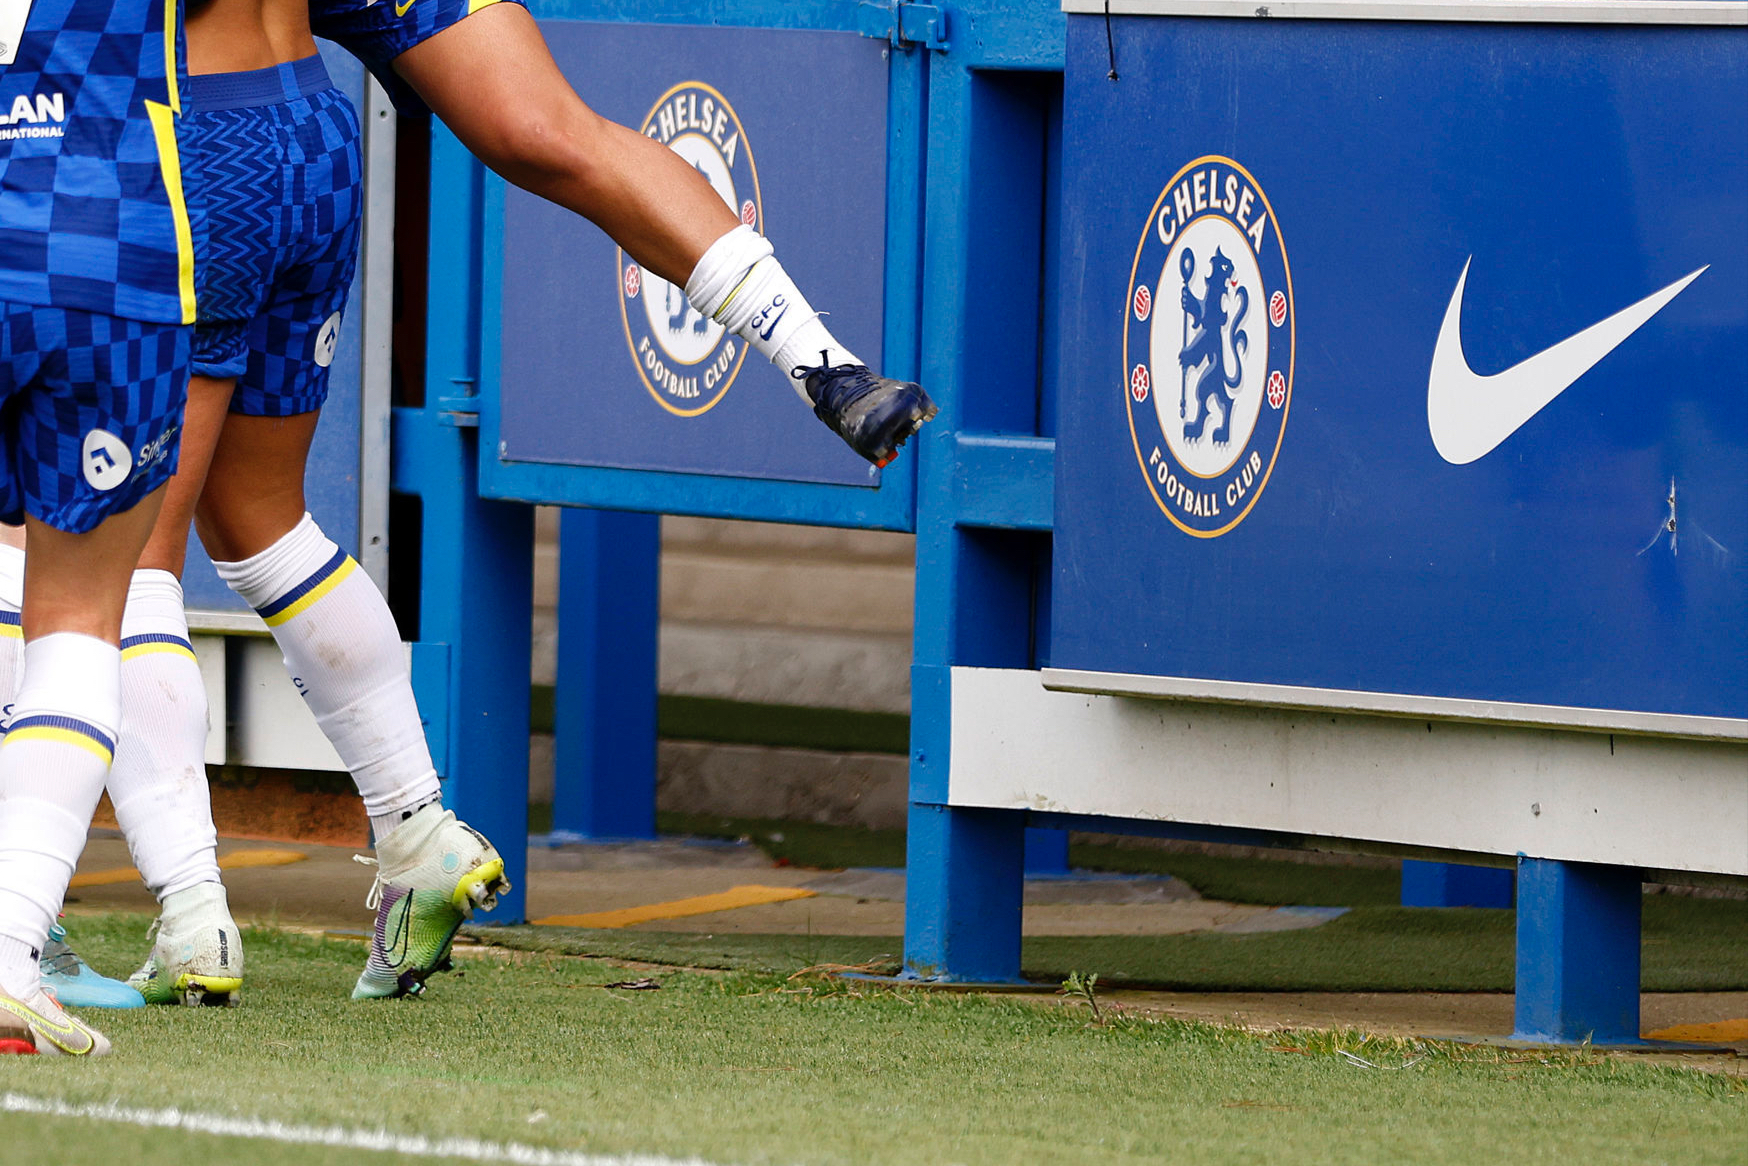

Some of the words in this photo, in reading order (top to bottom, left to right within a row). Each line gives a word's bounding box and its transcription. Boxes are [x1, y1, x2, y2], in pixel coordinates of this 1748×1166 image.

[1157, 170, 1267, 254] CHELSEA
[751, 294, 785, 329] CFC
[639, 335, 700, 398] FOOTBALL
[704, 340, 736, 389] CLUB
[1150, 446, 1220, 517] FOOTBALL
[1226, 451, 1262, 506] CLUB
